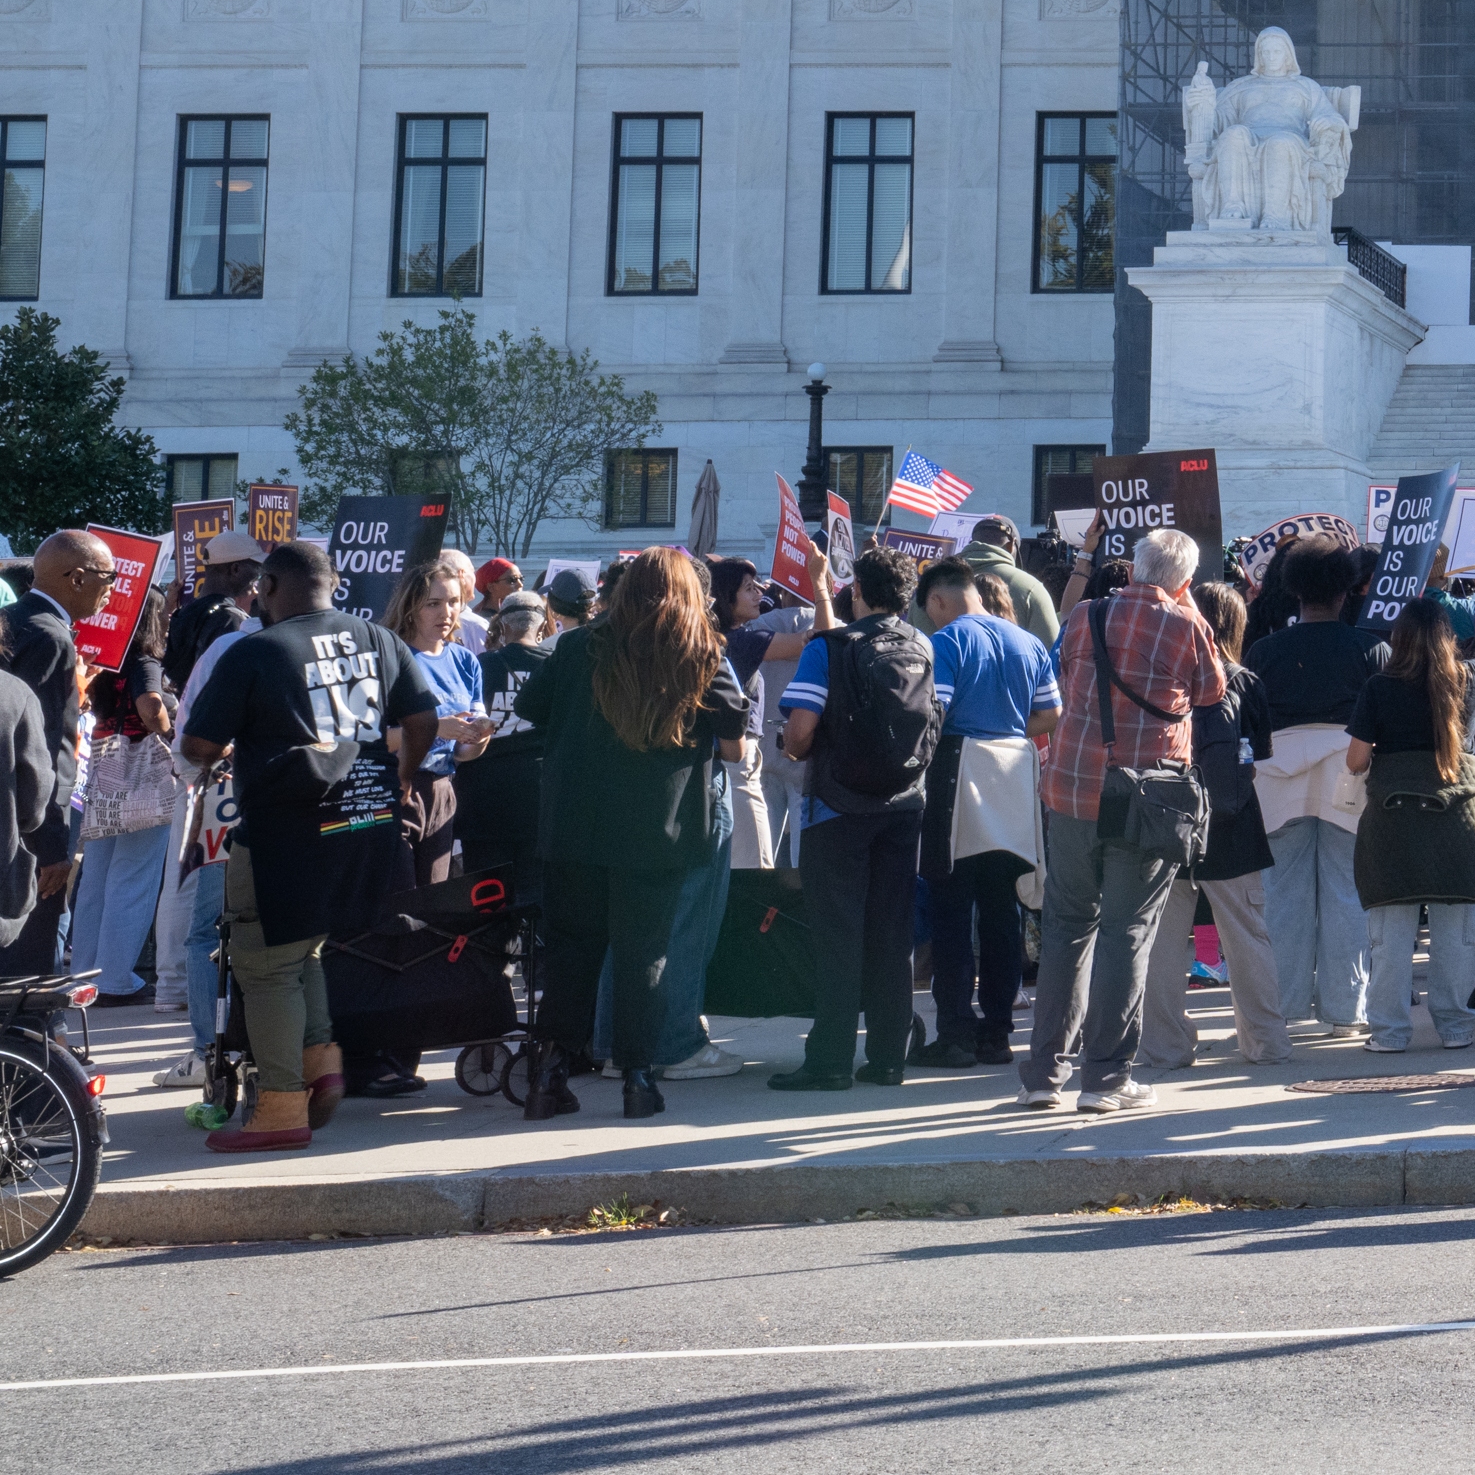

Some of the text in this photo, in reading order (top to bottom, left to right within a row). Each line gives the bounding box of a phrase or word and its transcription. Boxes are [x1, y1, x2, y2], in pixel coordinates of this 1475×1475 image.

[1180, 459, 1208, 472] ACLU
[259, 495, 290, 509] UNITE &
[1101, 478, 1150, 503] OUR
[420, 504, 445, 518] ACLU
[1102, 503, 1176, 530] VOICE
[1397, 497, 1432, 520] OUR
[255, 509, 294, 543] RISE
[339, 521, 389, 545] OUR
[783, 524, 799, 545] NOT
[1392, 519, 1439, 546] VOICE
[781, 540, 807, 568] POWER
[898, 541, 944, 560] UNITE &
[1104, 533, 1126, 557] IS
[183, 530, 196, 594] UNITE &
[335, 549, 406, 574] VOICE
[1384, 551, 1403, 571] IS
[1376, 576, 1418, 597] OUR
[311, 631, 357, 659] IT'S
[304, 651, 379, 688] ABOUT
[308, 678, 382, 743] US
[95, 799, 107, 808] YOU
[108, 800, 121, 810] ARE
[96, 810, 107, 819] YOU
[108, 811, 121, 820] ARE
[96, 818, 108, 827] YOU
[102, 827, 116, 836] YOU
